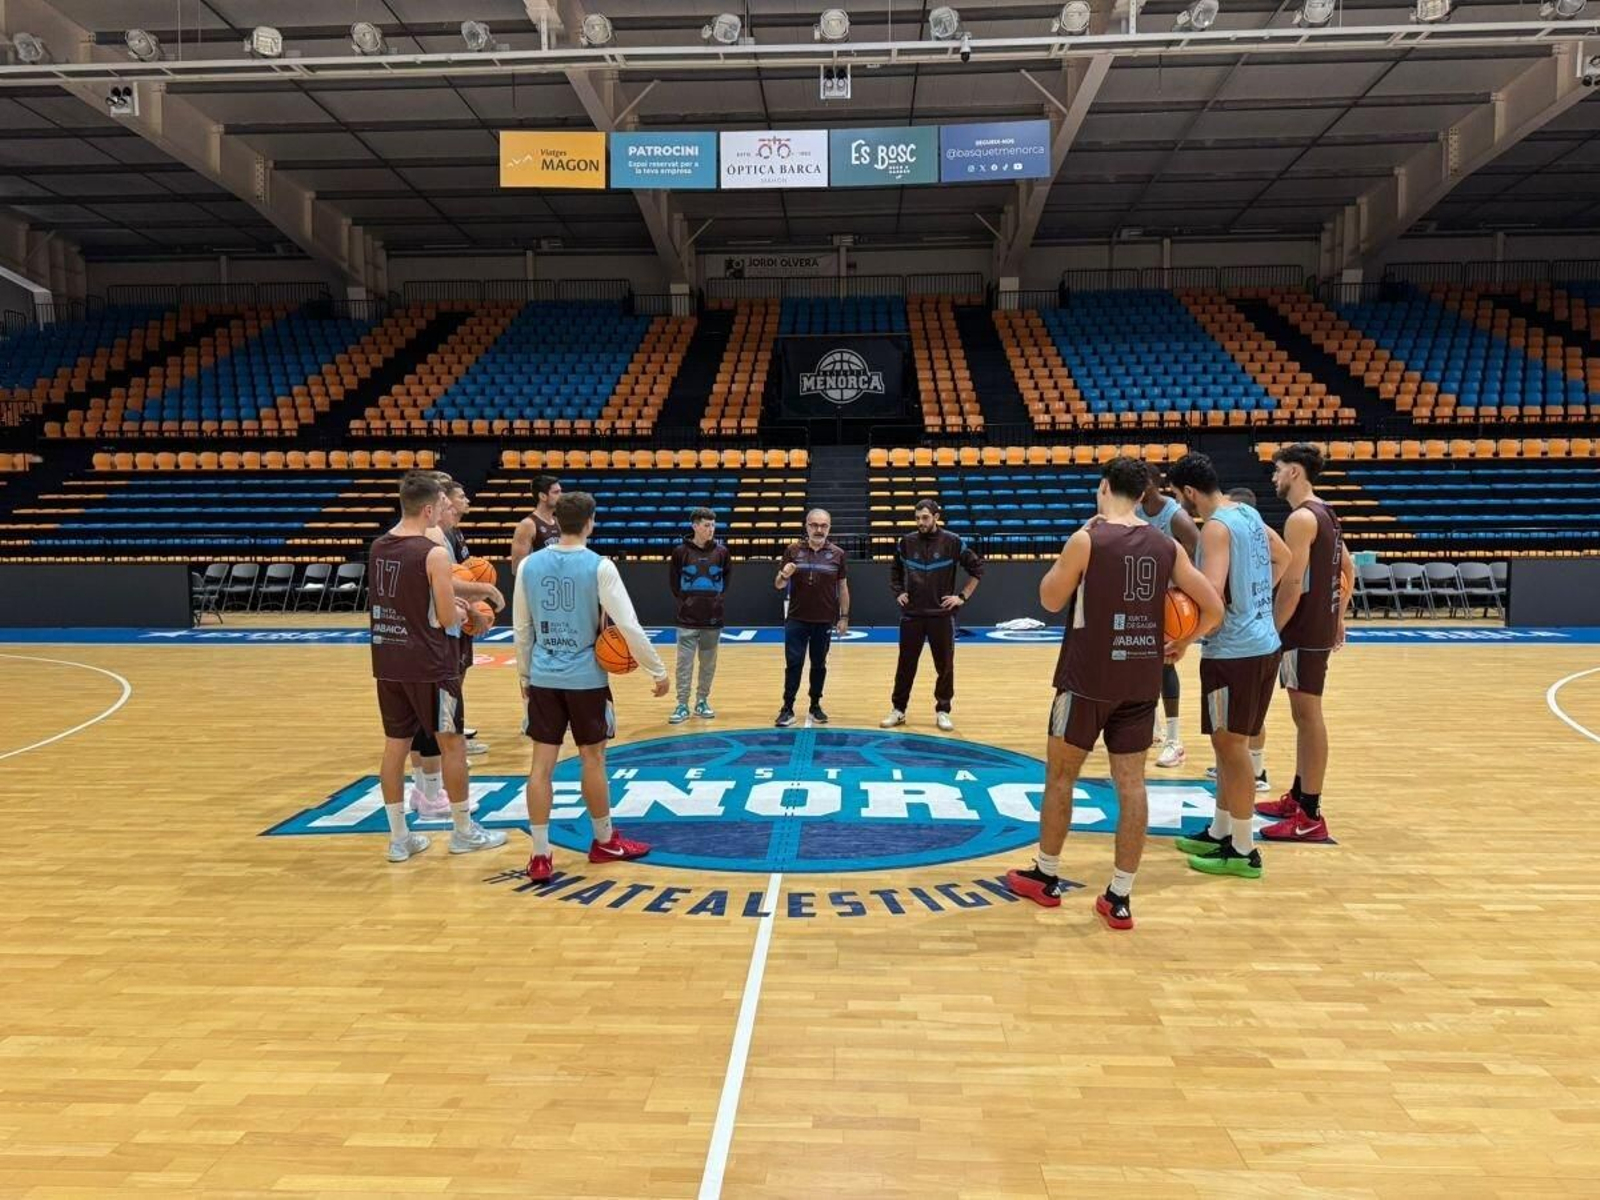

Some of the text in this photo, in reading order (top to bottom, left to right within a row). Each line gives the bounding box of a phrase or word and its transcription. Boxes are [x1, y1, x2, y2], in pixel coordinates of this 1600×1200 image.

[540, 148, 567, 158] Viatges
[628, 146, 699, 156] PATROCINI
[946, 145, 1045, 161] @basquetmenorca
[540, 159, 600, 172] MAGON
[660, 168, 692, 176] empresa
[747, 257, 819, 268] JORDI OLVERA
[802, 374, 882, 392] MENORCA
[375, 559, 401, 598] 17
[1123, 555, 1157, 601] 19
[540, 575, 575, 612] 30
